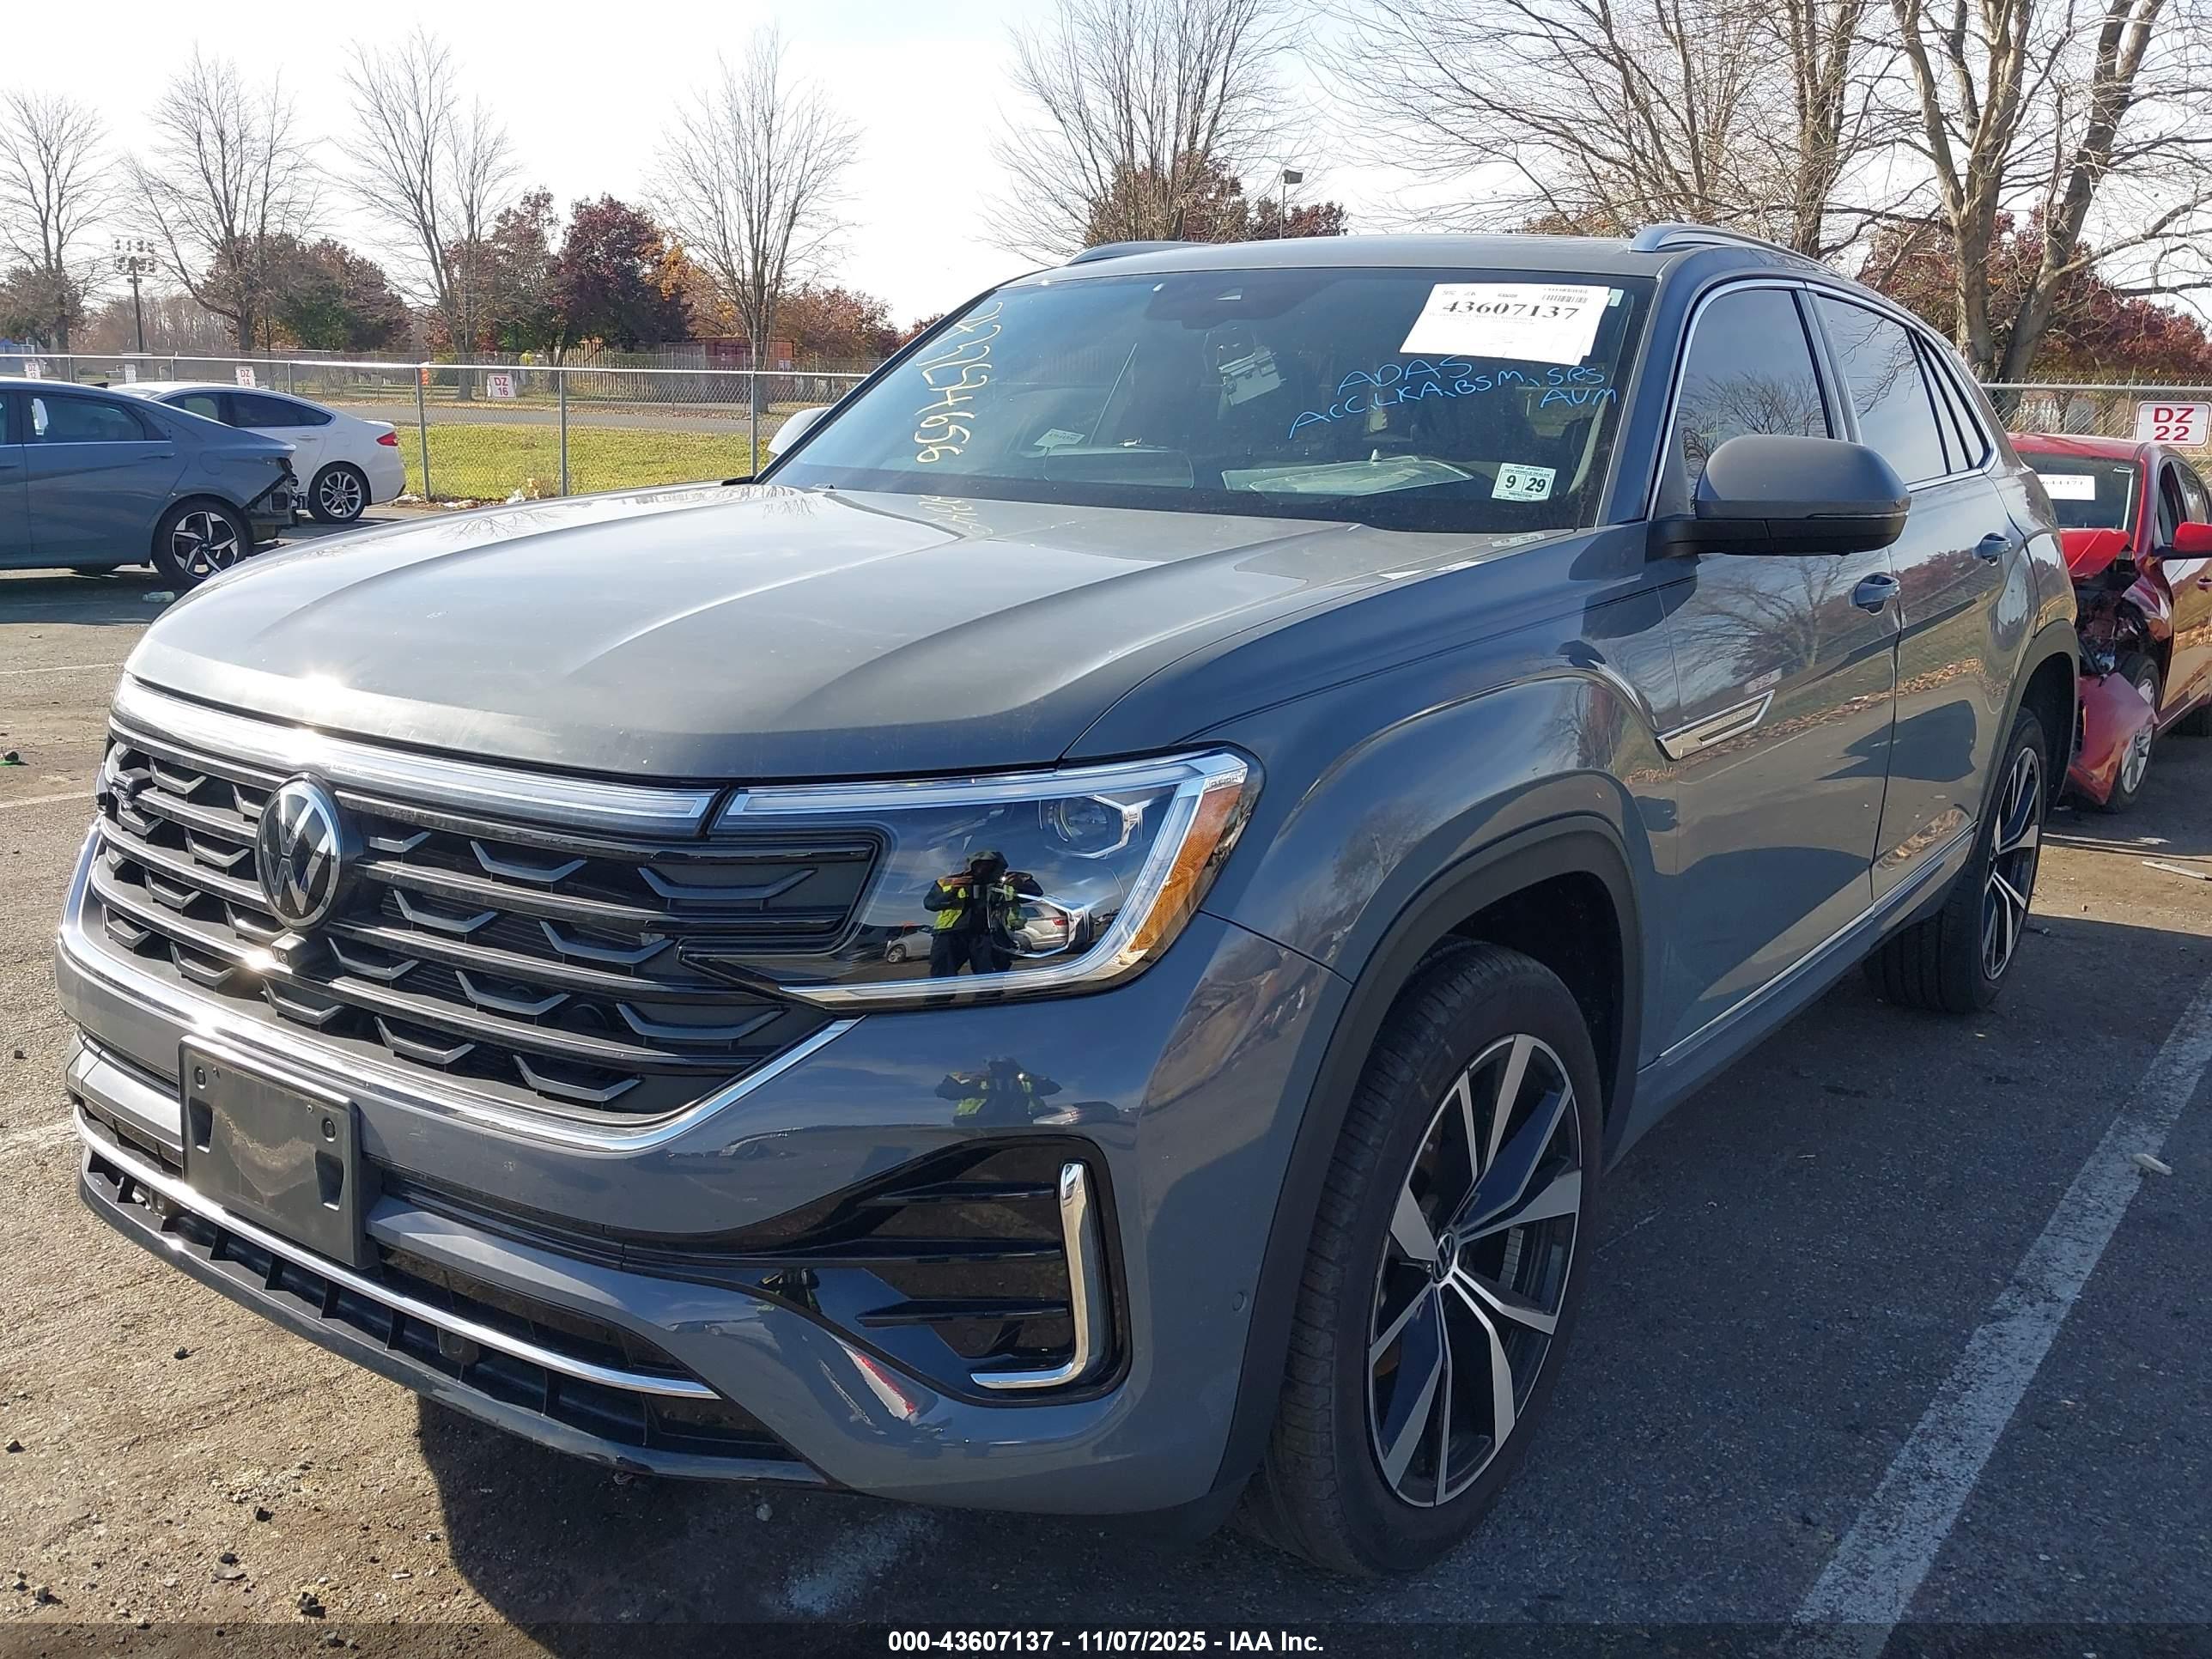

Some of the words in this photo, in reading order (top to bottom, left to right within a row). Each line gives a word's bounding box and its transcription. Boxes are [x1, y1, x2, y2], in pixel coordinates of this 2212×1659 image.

[1443, 301, 1580, 320] 43607137
[240, 369, 251, 378] DZ
[494, 377, 509, 386] DZ
[1337, 356, 1473, 396] ADAS
[498, 386, 509, 397] 16
[2153, 407, 2195, 424] DZ
[2154, 425, 2191, 441] 22
[1505, 475, 1516, 489] 9
[1524, 477, 1547, 493] 29
